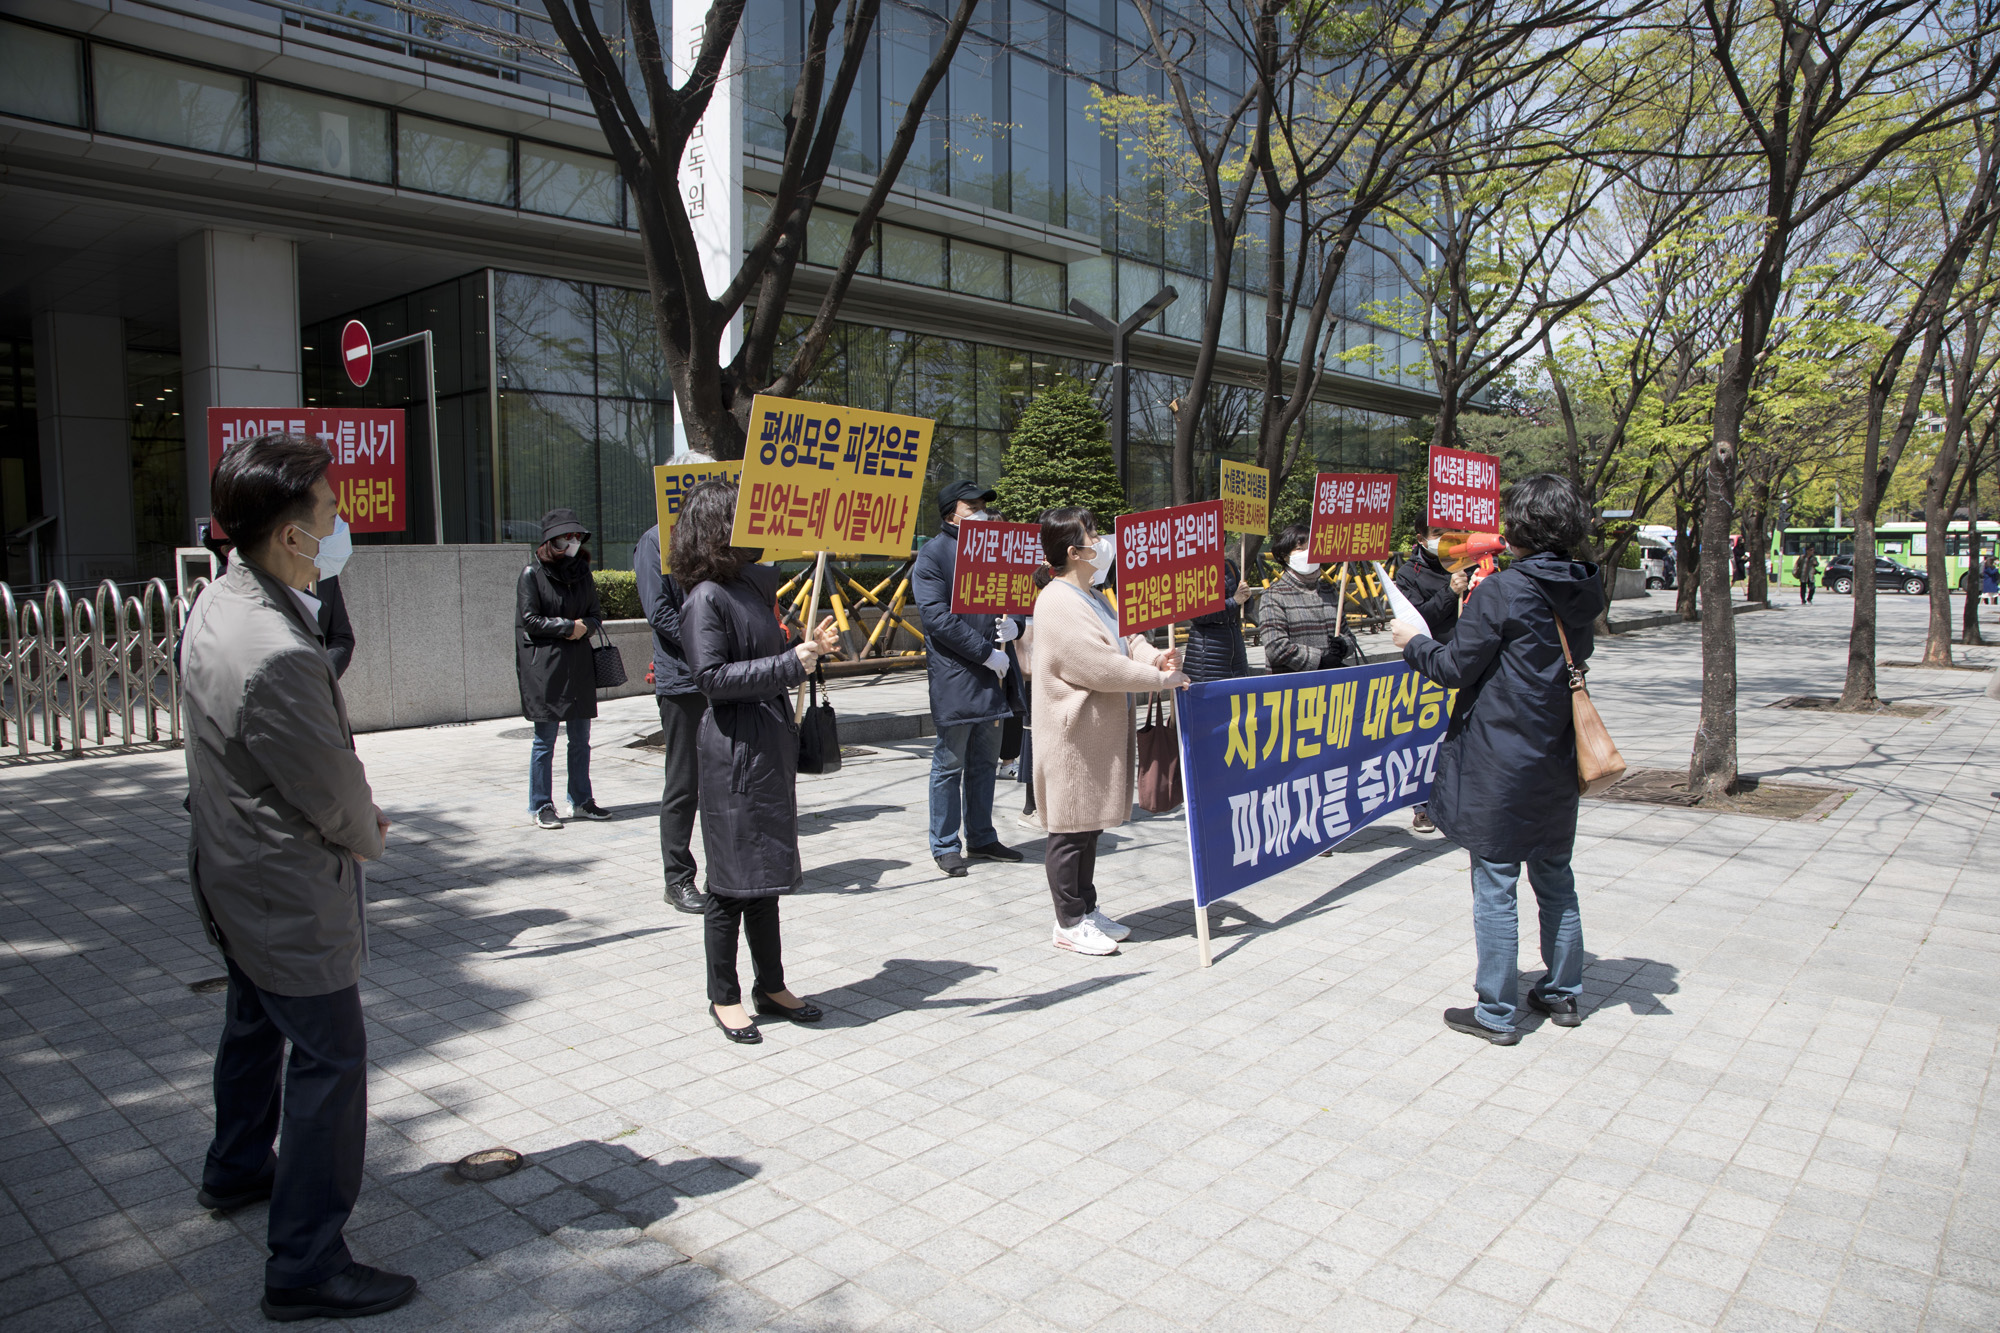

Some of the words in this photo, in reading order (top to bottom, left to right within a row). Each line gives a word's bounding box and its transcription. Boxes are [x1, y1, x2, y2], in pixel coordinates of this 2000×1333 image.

[759, 410, 841, 471] 평생모은
[843, 422, 920, 479] 피같은돈
[1247, 472, 1267, 500] 라임몸통
[1433, 454, 1465, 486] 대신증권
[1466, 459, 1496, 491] 불법사기
[337, 478, 395, 523] 사하라
[747, 482, 831, 540] 믿었는데
[833, 490, 909, 545] 이꼴이냐
[1223, 498, 1245, 526] 양홍석을
[1246, 503, 1266, 529] 조사하라
[1319, 480, 1355, 515] 양홍석을
[1355, 481, 1391, 514] 수사하라
[1432, 490, 1464, 523] 은퇴자금
[963, 528, 999, 563] 사기꾼
[1123, 518, 1171, 570] 양홍석의
[1174, 510, 1219, 559] 검은비리
[1313, 523, 1352, 556] 大信사기
[1351, 522, 1387, 555] 몸통이다
[959, 571, 973, 607] 내
[973, 572, 1008, 607] 노후를
[1124, 573, 1172, 626] 금감원은
[1175, 564, 1219, 613] 밝혀다오
[1223, 680, 1359, 770] 사기판매
[1228, 765, 1351, 867] 피해자들
